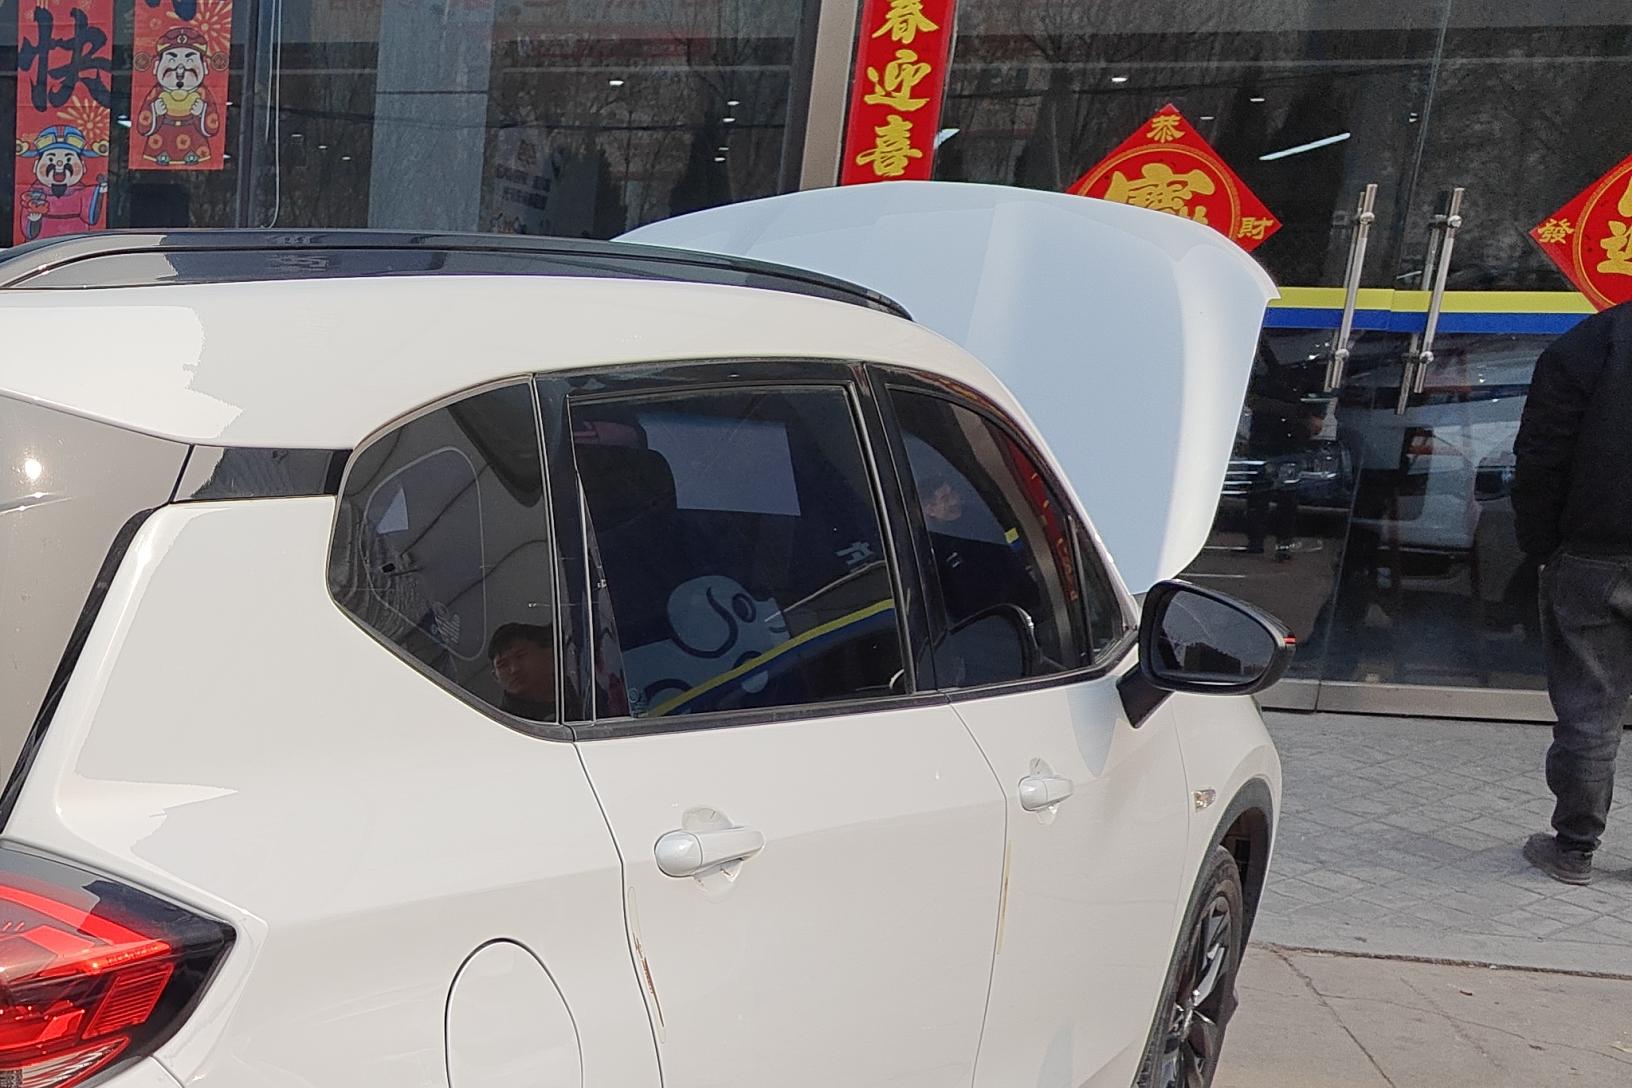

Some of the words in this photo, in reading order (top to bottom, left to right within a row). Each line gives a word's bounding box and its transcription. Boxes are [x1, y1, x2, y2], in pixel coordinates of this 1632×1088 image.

[19, 7, 113, 113] 快
[1146, 114, 1186, 143] 恭
[1237, 217, 1274, 240] 財
[1537, 218, 1575, 244] 發
